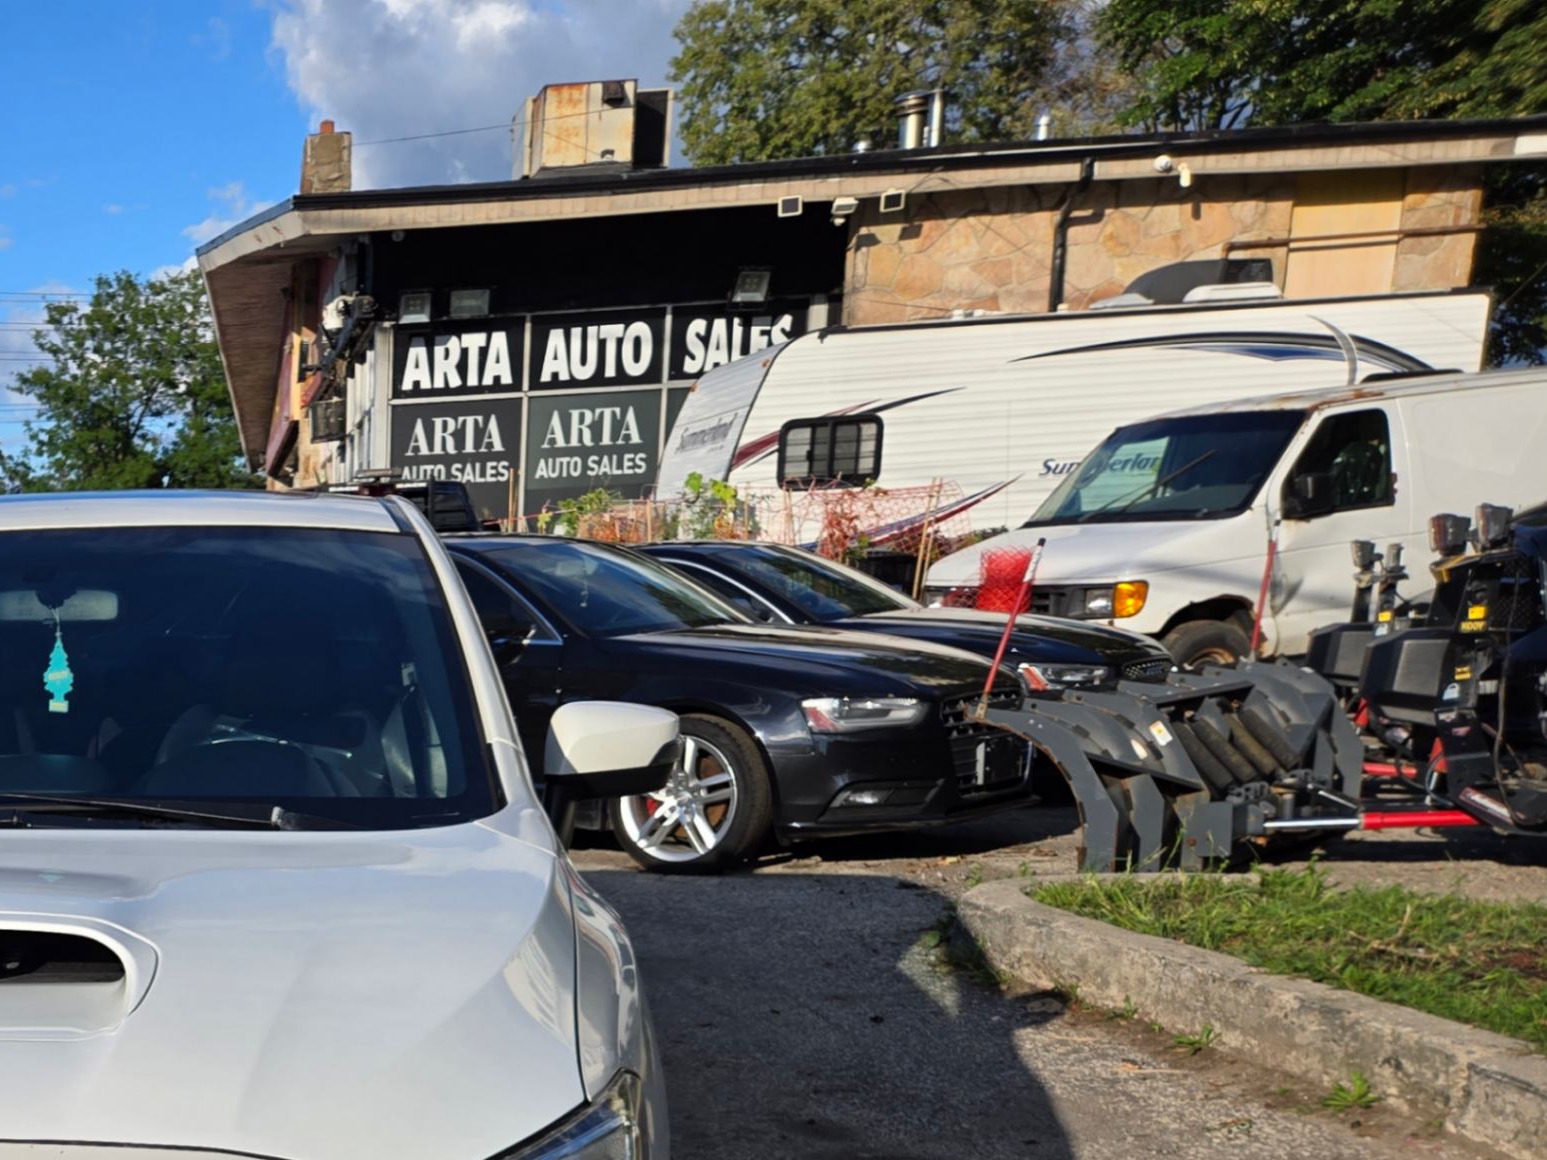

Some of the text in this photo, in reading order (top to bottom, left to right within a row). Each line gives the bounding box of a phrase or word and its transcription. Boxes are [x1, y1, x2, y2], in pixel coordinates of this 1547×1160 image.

[401, 331, 513, 391] ARTA
[540, 321, 653, 382] AUTO
[405, 414, 505, 456] ARTA
[541, 406, 643, 449] ARTA
[401, 461, 509, 483] AUTO SALES
[535, 453, 648, 479] AUTO SALES
